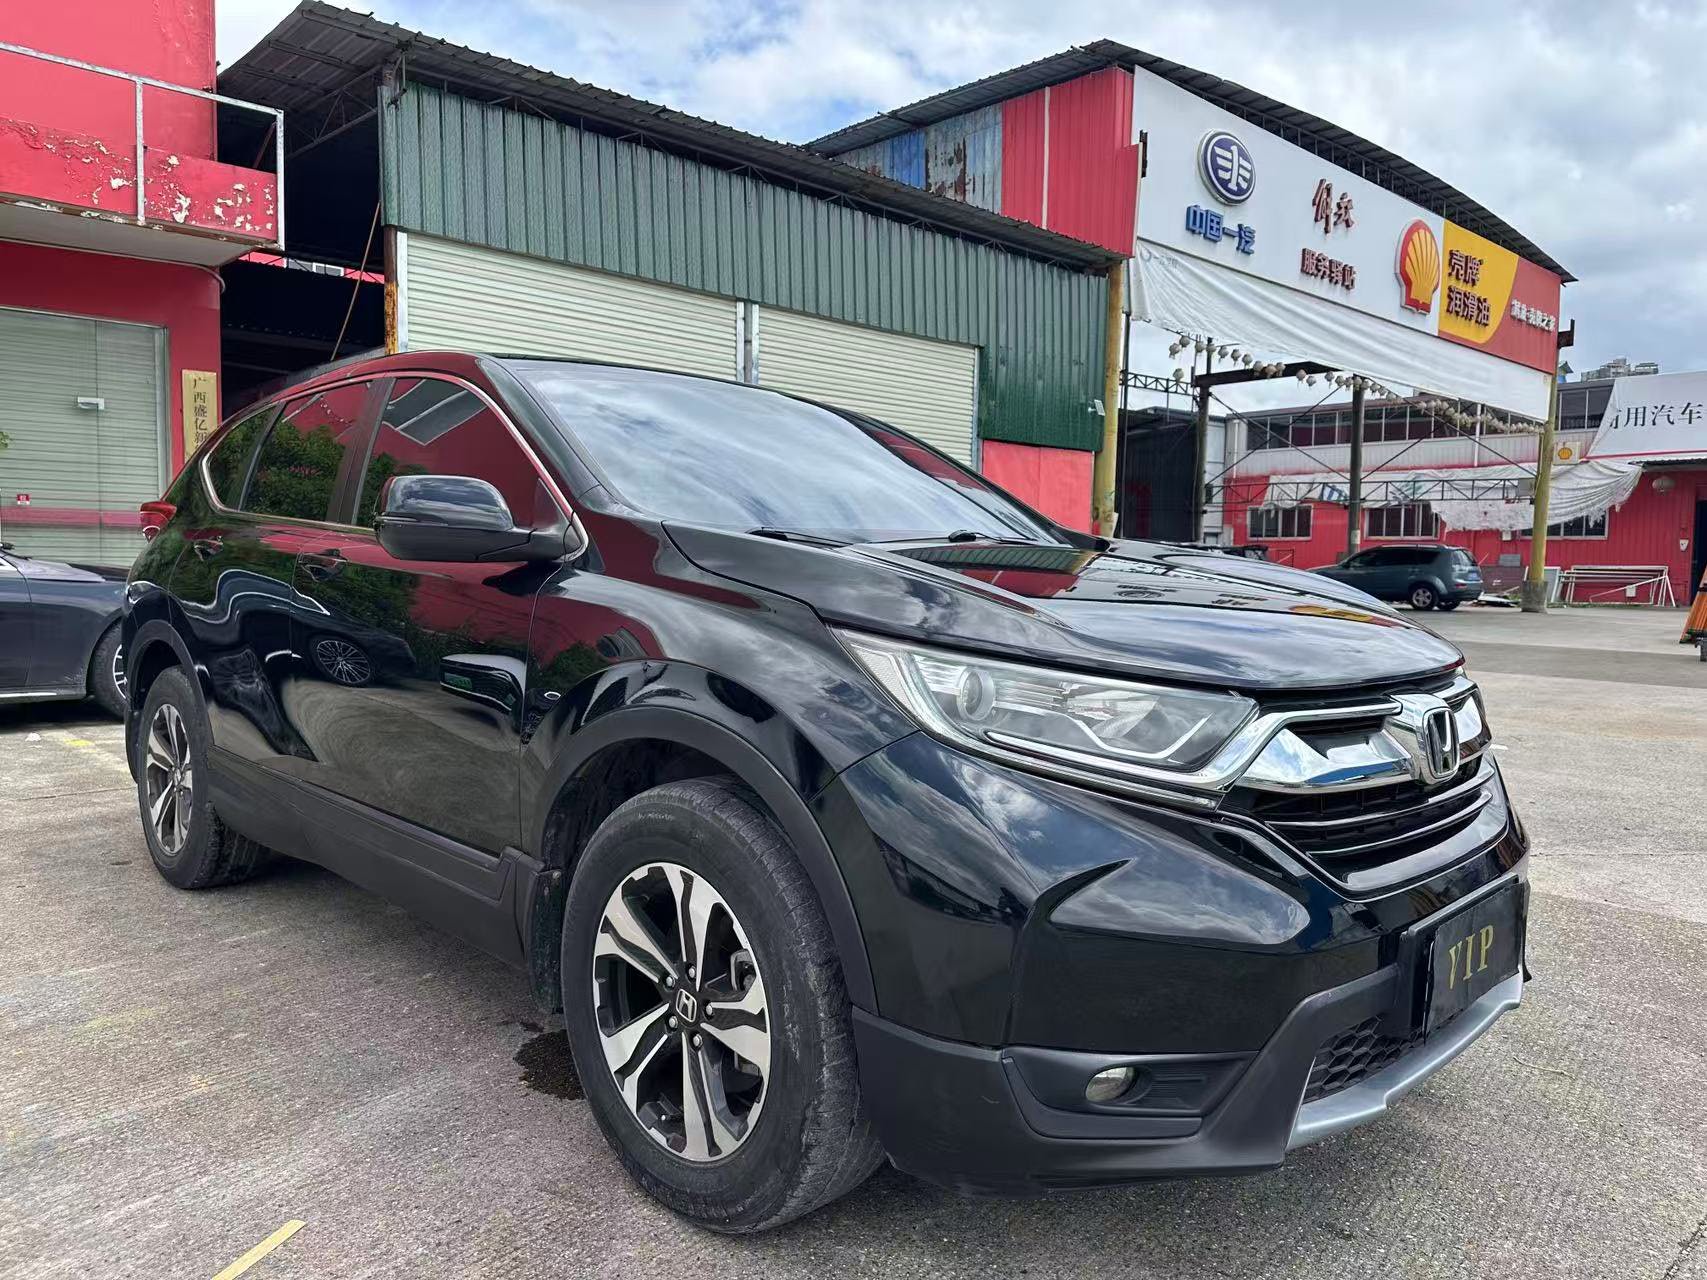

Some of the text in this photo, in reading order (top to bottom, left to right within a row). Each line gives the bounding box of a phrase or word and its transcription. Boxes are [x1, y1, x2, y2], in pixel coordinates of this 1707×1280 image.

[1186, 205, 1256, 255] 中国一汽
[1302, 247, 1356, 290] 服务驿站
[1448, 250, 1481, 287] 壳牌
[1447, 285, 1490, 327] 润滑油
[1449, 925, 1494, 989] VIP
